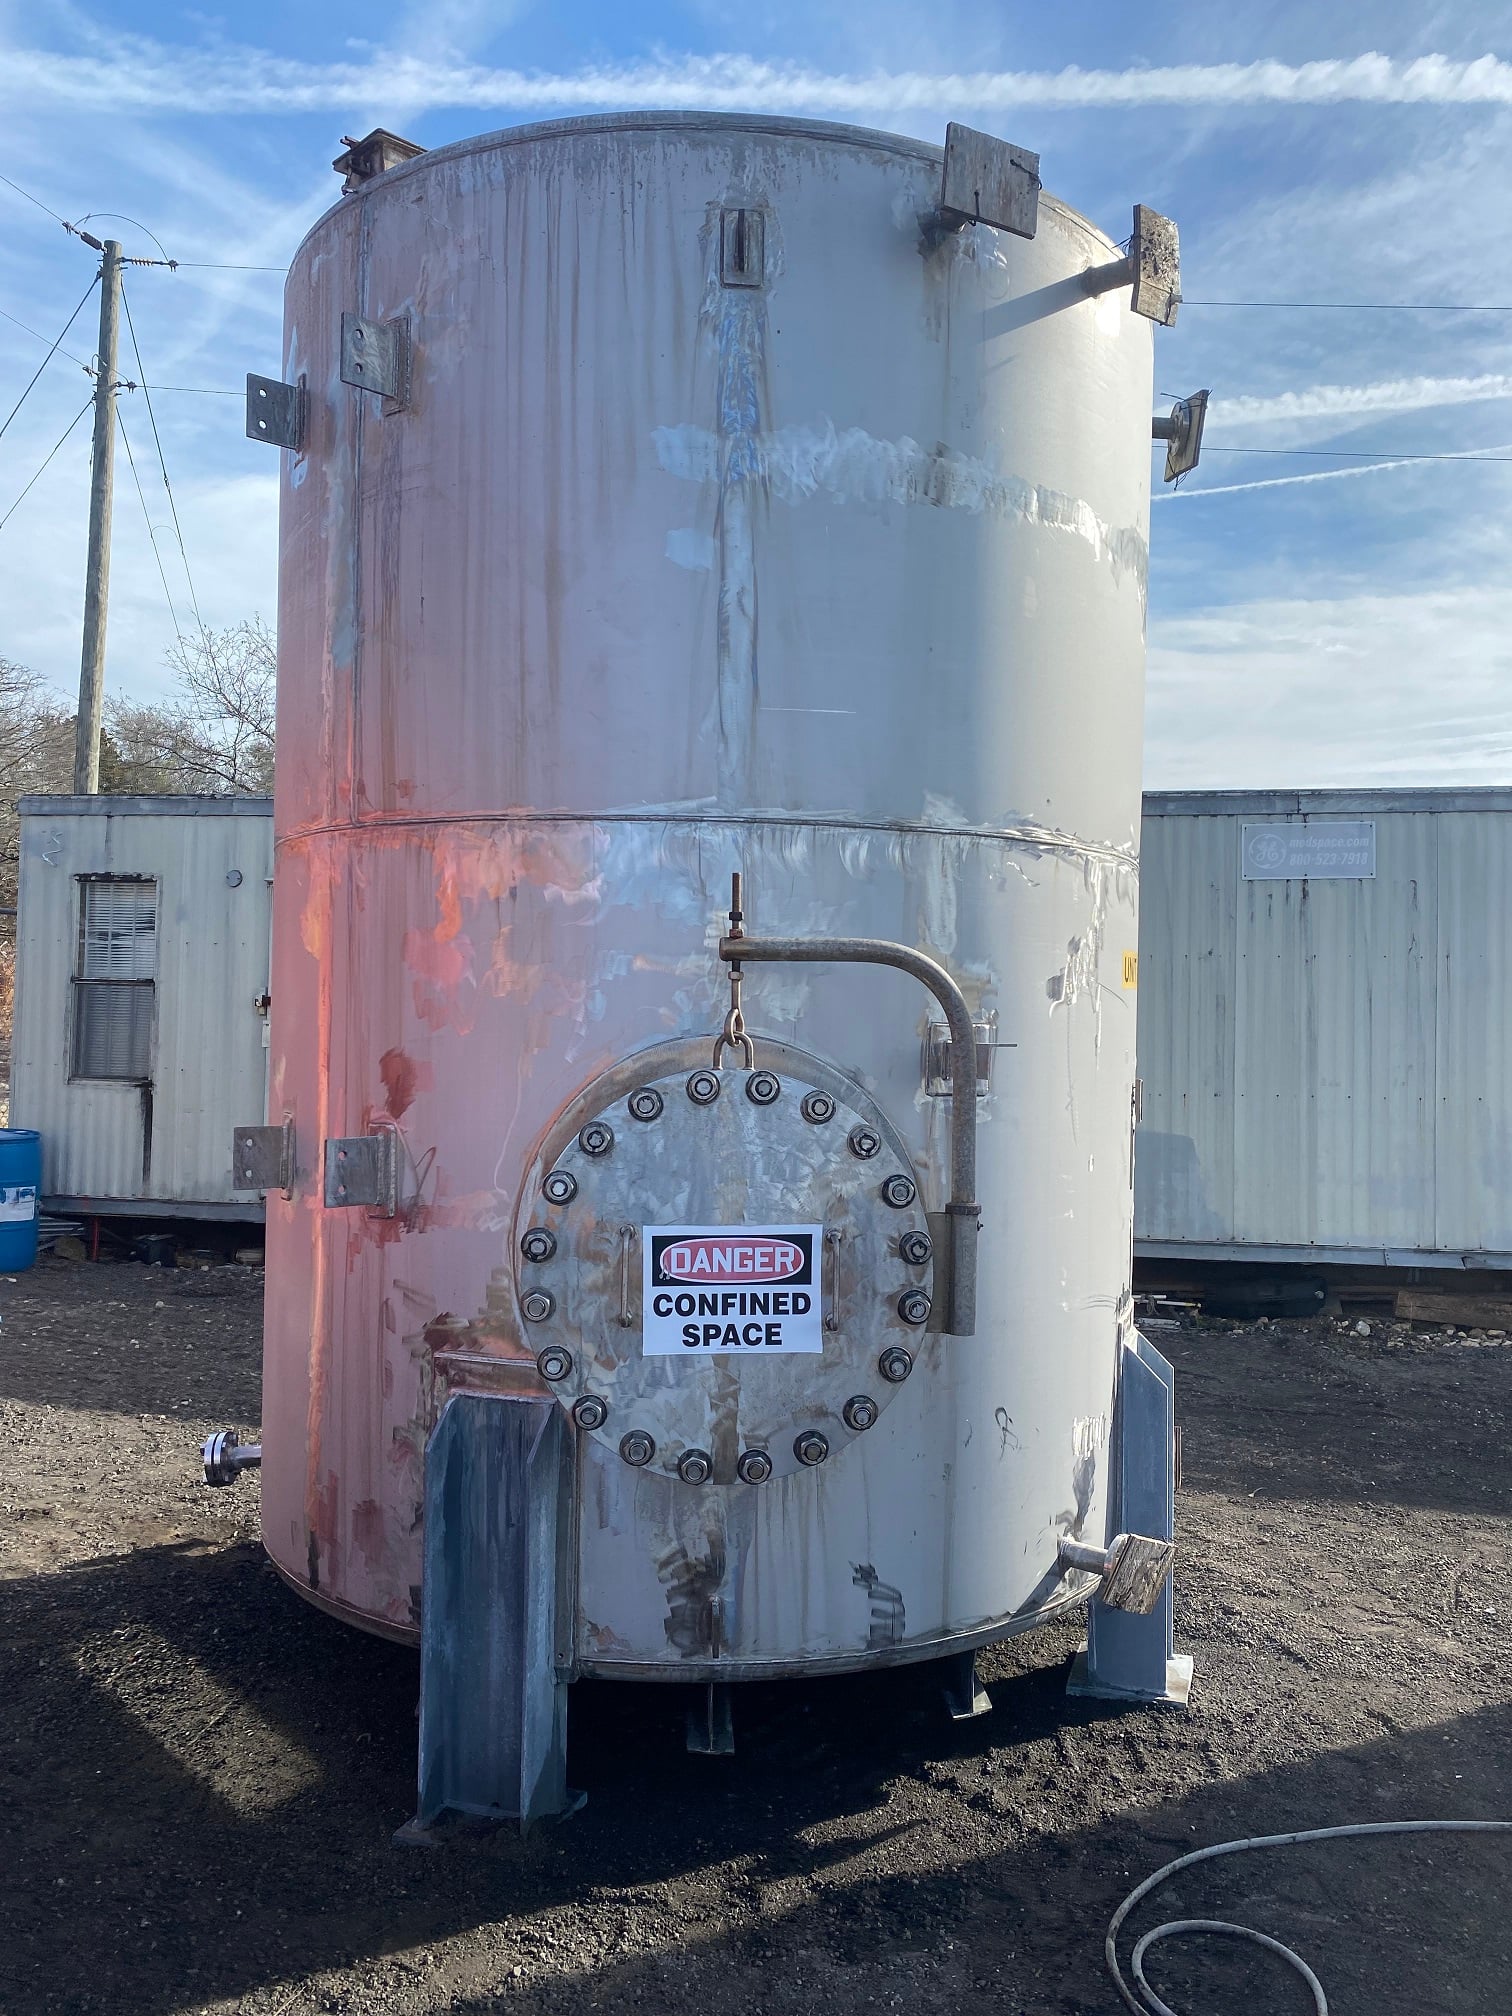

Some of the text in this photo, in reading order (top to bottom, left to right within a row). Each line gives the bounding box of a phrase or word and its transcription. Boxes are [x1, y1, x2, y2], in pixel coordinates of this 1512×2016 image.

[1289, 836, 1370, 850] modspace.com
[1289, 851, 1369, 866] 800-523-7918
[670, 1247, 795, 1273] DANGER
[653, 1292, 811, 1317] CONFINED
[682, 1323, 782, 1347] SPACE
